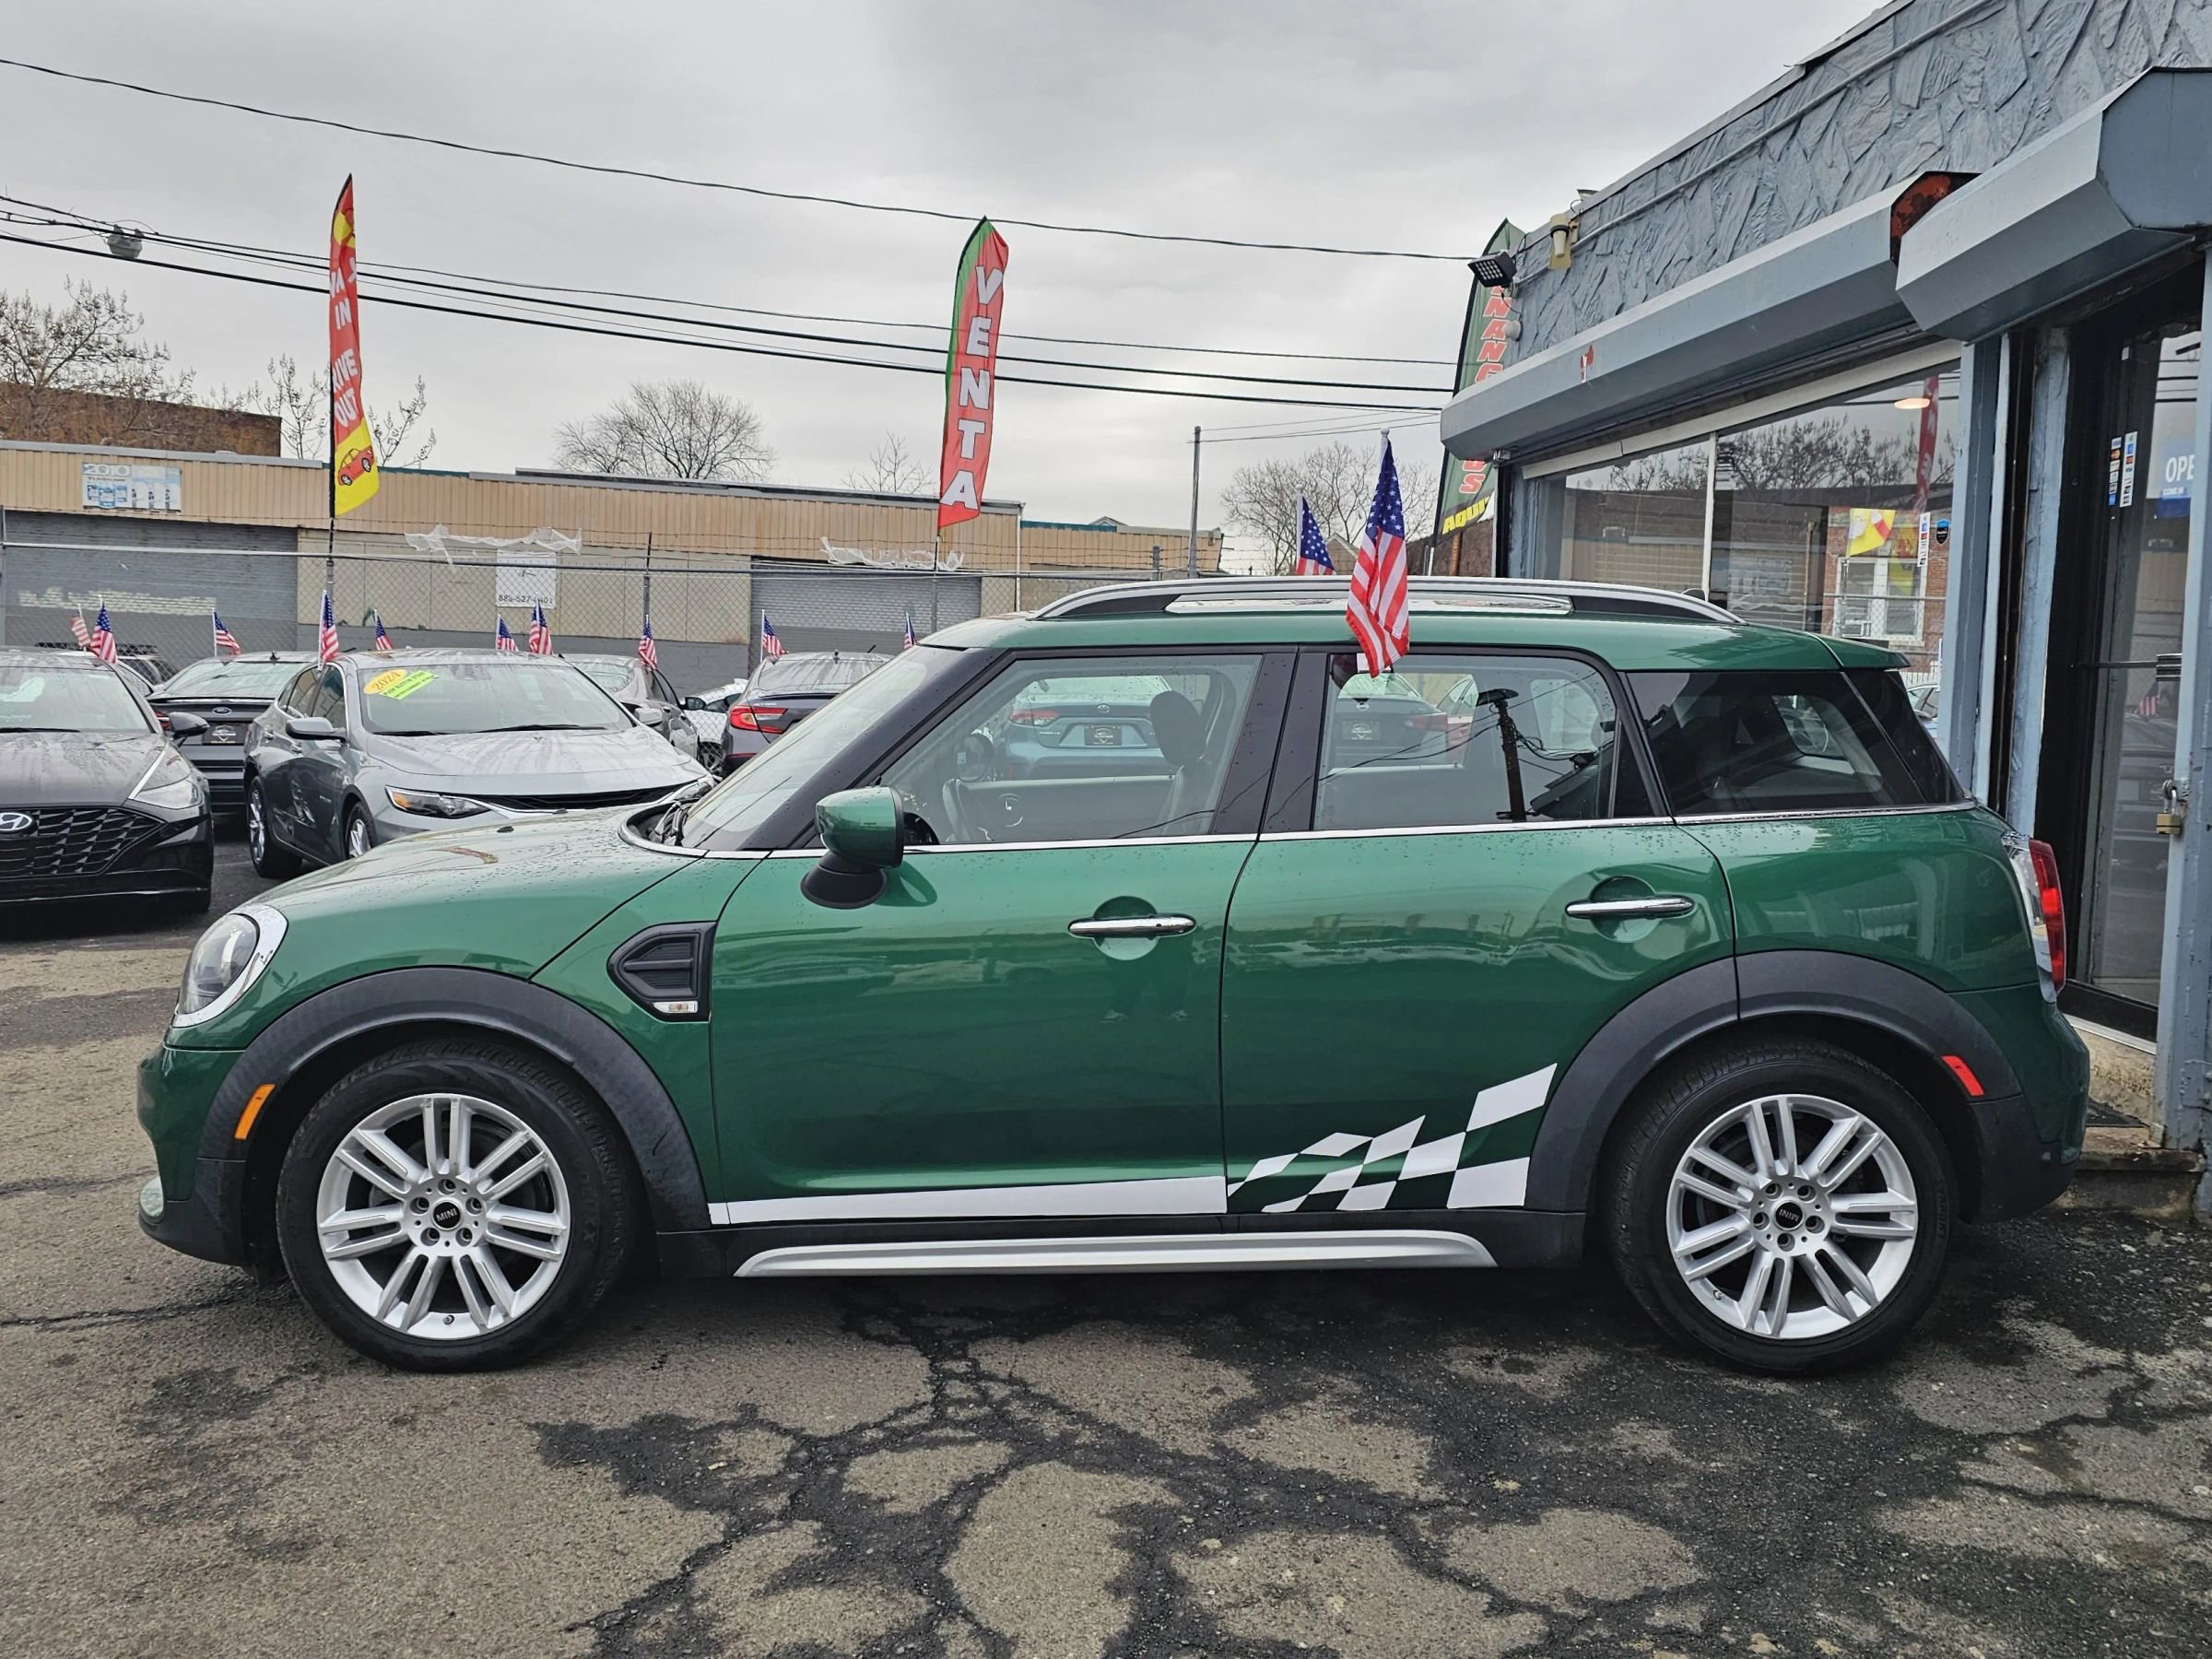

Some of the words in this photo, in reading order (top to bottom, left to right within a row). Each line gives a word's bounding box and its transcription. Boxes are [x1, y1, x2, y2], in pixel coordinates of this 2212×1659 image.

[939, 265, 1005, 511] VENTA
[2166, 454, 2195, 483] OPE
[435, 1208, 458, 1221] MINI
[1779, 1209, 1799, 1222] MINI
